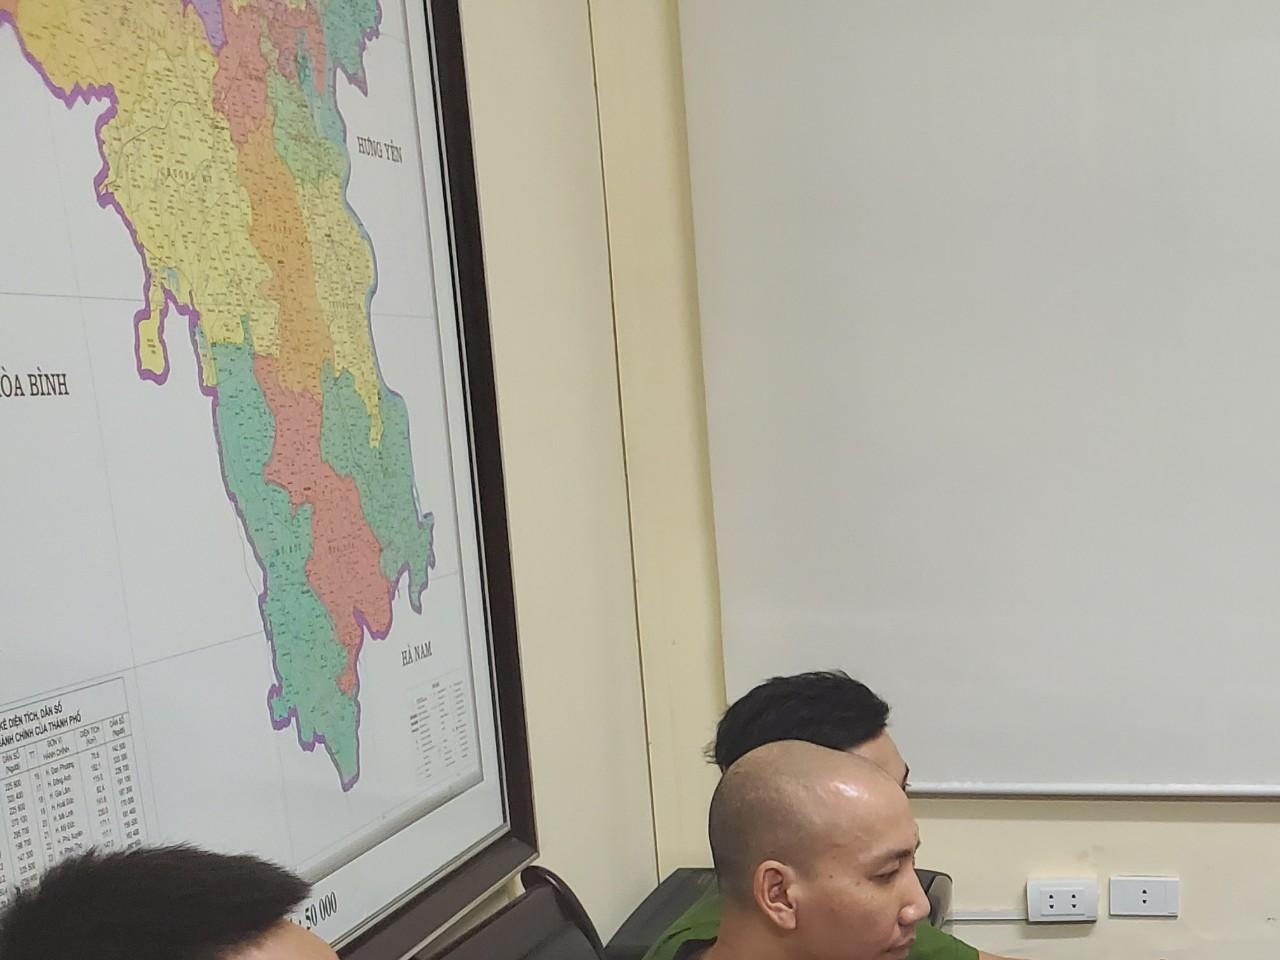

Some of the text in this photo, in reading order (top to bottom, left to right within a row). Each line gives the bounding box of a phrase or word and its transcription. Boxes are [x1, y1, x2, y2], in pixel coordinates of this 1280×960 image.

[356, 136, 403, 164] HƯNG YÊN
[0, 366, 70, 397] ÒA BÌNH
[401, 641, 433, 666] HÀ NAM
[319, 891, 337, 921] 000
